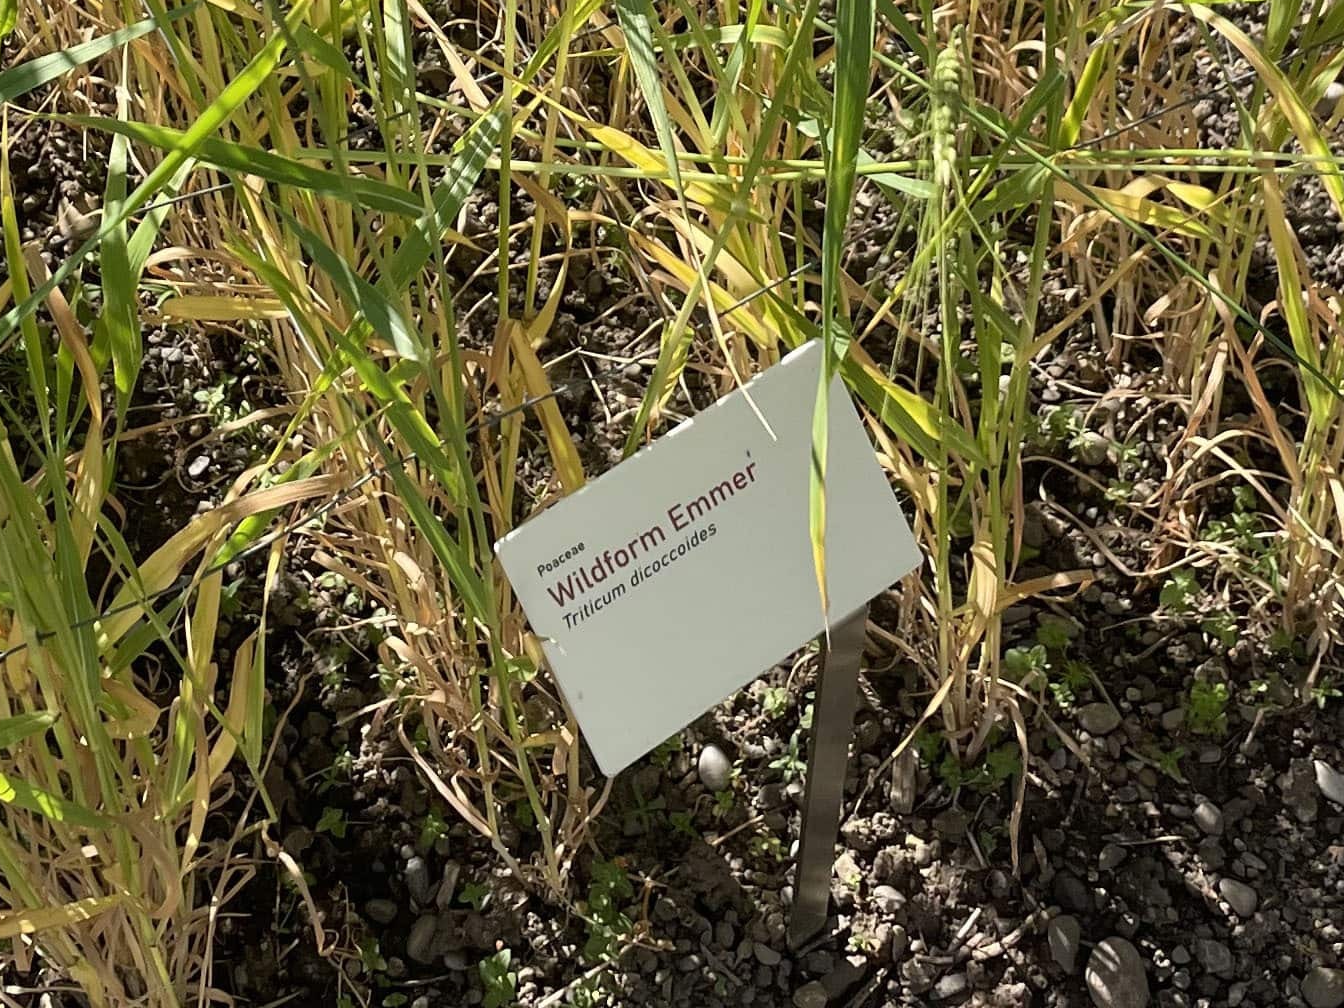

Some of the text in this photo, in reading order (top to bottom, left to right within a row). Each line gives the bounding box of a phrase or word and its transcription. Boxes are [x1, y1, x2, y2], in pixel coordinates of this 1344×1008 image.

[537, 542, 585, 577] Poaceae
[546, 462, 756, 607] Wildform Emmer
[562, 523, 717, 630] Triticum dicoccoides
